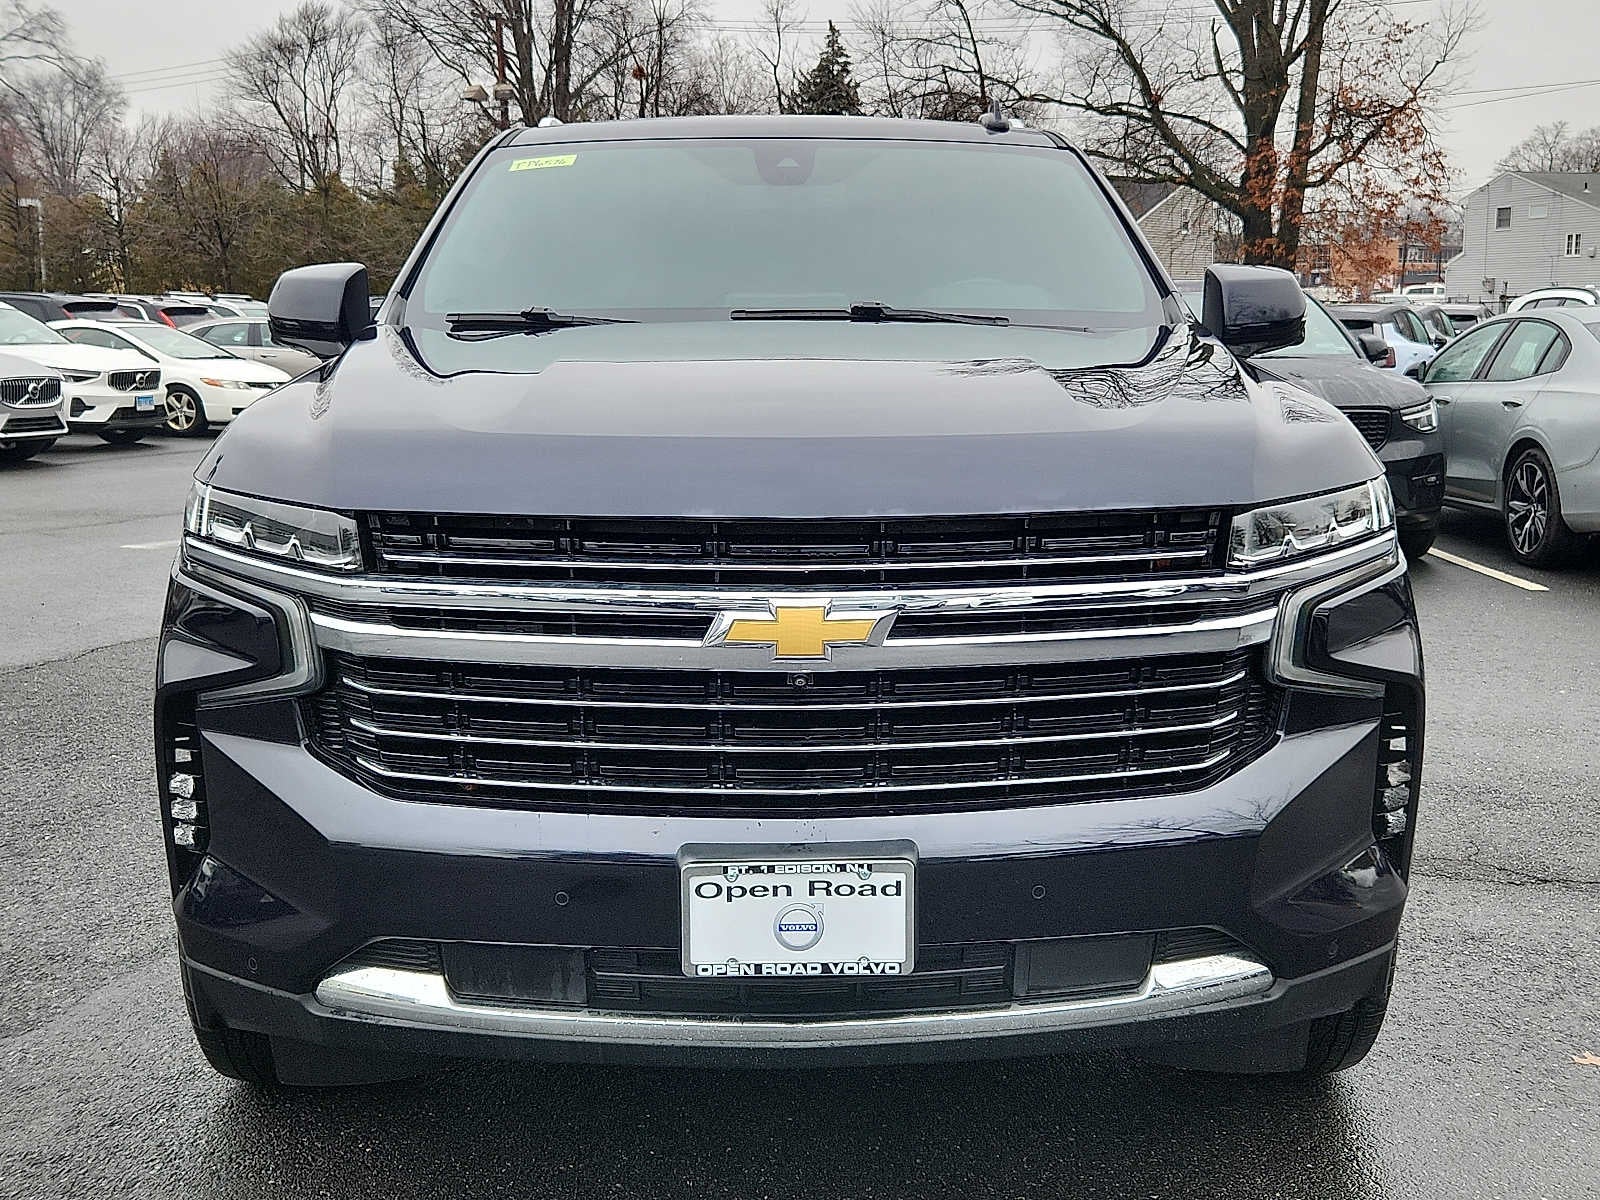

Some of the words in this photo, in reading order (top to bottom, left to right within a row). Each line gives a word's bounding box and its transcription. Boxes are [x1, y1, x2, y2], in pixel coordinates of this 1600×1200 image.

[760, 865, 768, 874] 1
[694, 882, 792, 902] Open
[808, 880, 902, 897] Road
[696, 963, 755, 975] OPEN
[762, 963, 822, 975] ROAD
[828, 962, 901, 975] VOLVO
